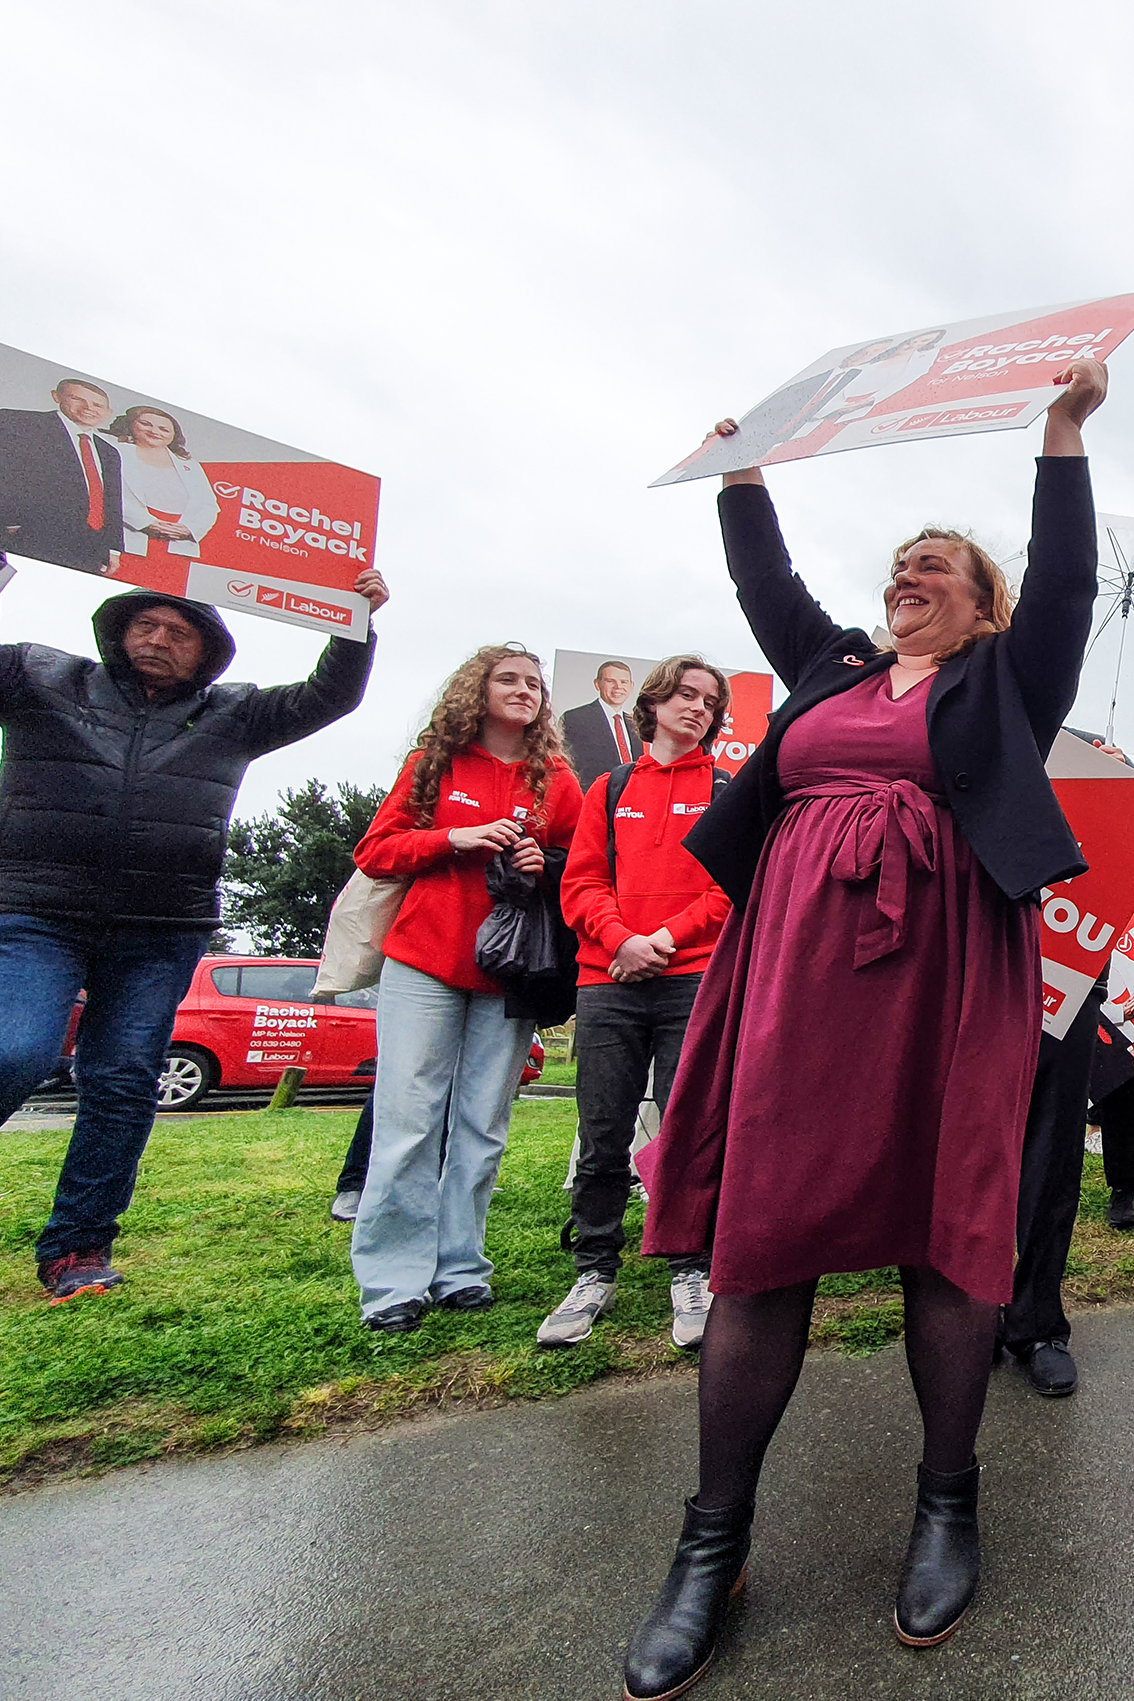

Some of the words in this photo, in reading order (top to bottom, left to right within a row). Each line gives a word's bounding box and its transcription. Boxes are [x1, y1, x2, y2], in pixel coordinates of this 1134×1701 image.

[960, 328, 1113, 359] Rachel
[941, 344, 1104, 375] Boyack
[927, 377, 950, 386] for
[951, 369, 1010, 382] Nelson
[939, 406, 1018, 424] Labour
[241, 486, 361, 540] Rachel
[235, 529, 257, 542] for
[259, 536, 309, 558] Nelson
[239, 507, 367, 562] Boyack
[290, 597, 347, 621] Labour
[253, 1015, 318, 1030] Boyack
[256, 1005, 315, 1017] Rachel
[263, 1053, 296, 1061] Labour
